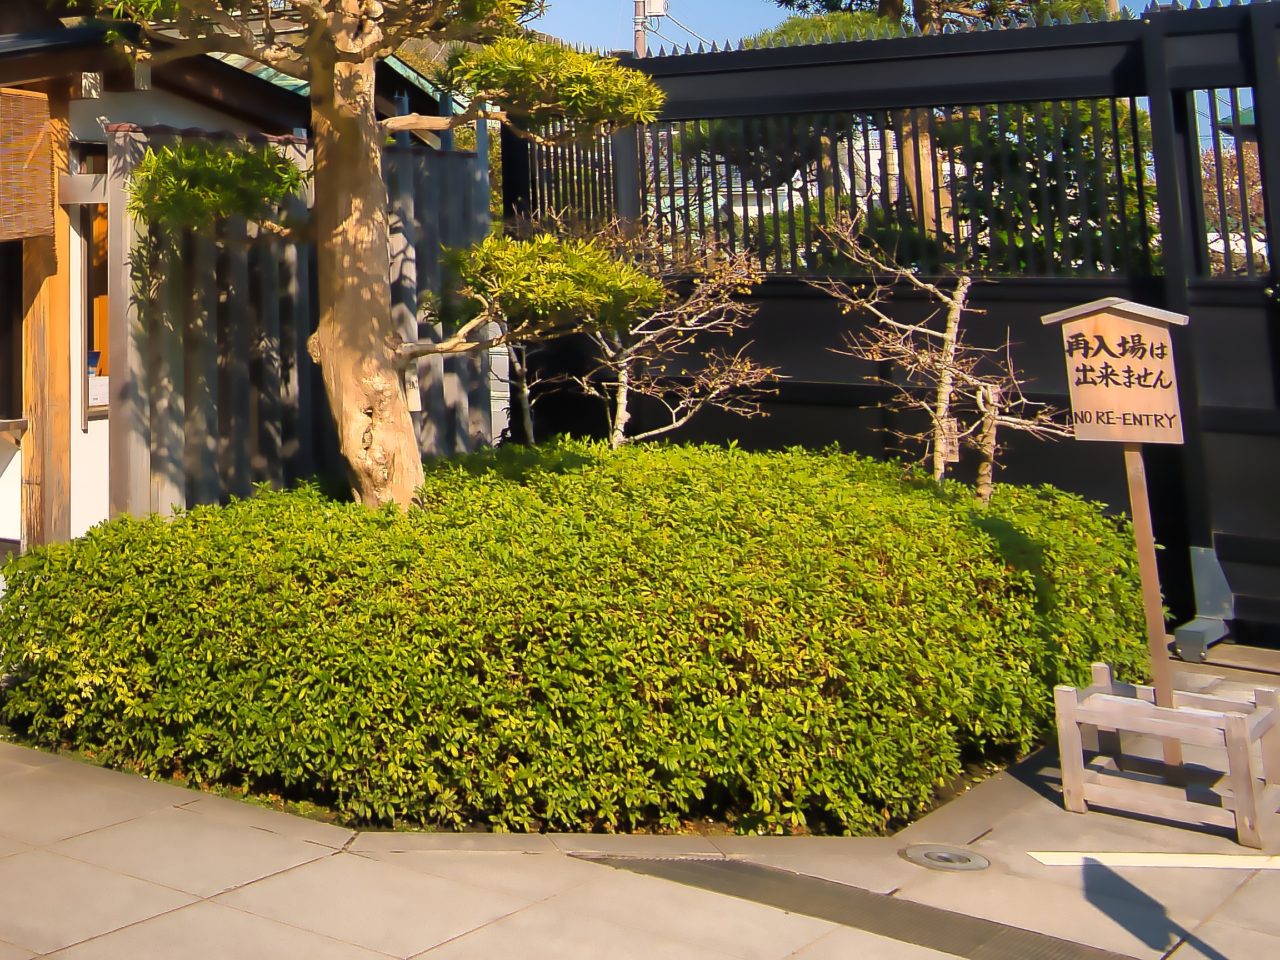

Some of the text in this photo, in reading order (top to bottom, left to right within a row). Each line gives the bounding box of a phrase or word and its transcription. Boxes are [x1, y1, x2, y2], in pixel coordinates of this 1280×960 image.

[1066, 332, 1167, 360] 再入場は
[1074, 361, 1173, 390] 出来ません
[1074, 411, 1177, 428] NO RE-ENTRY
